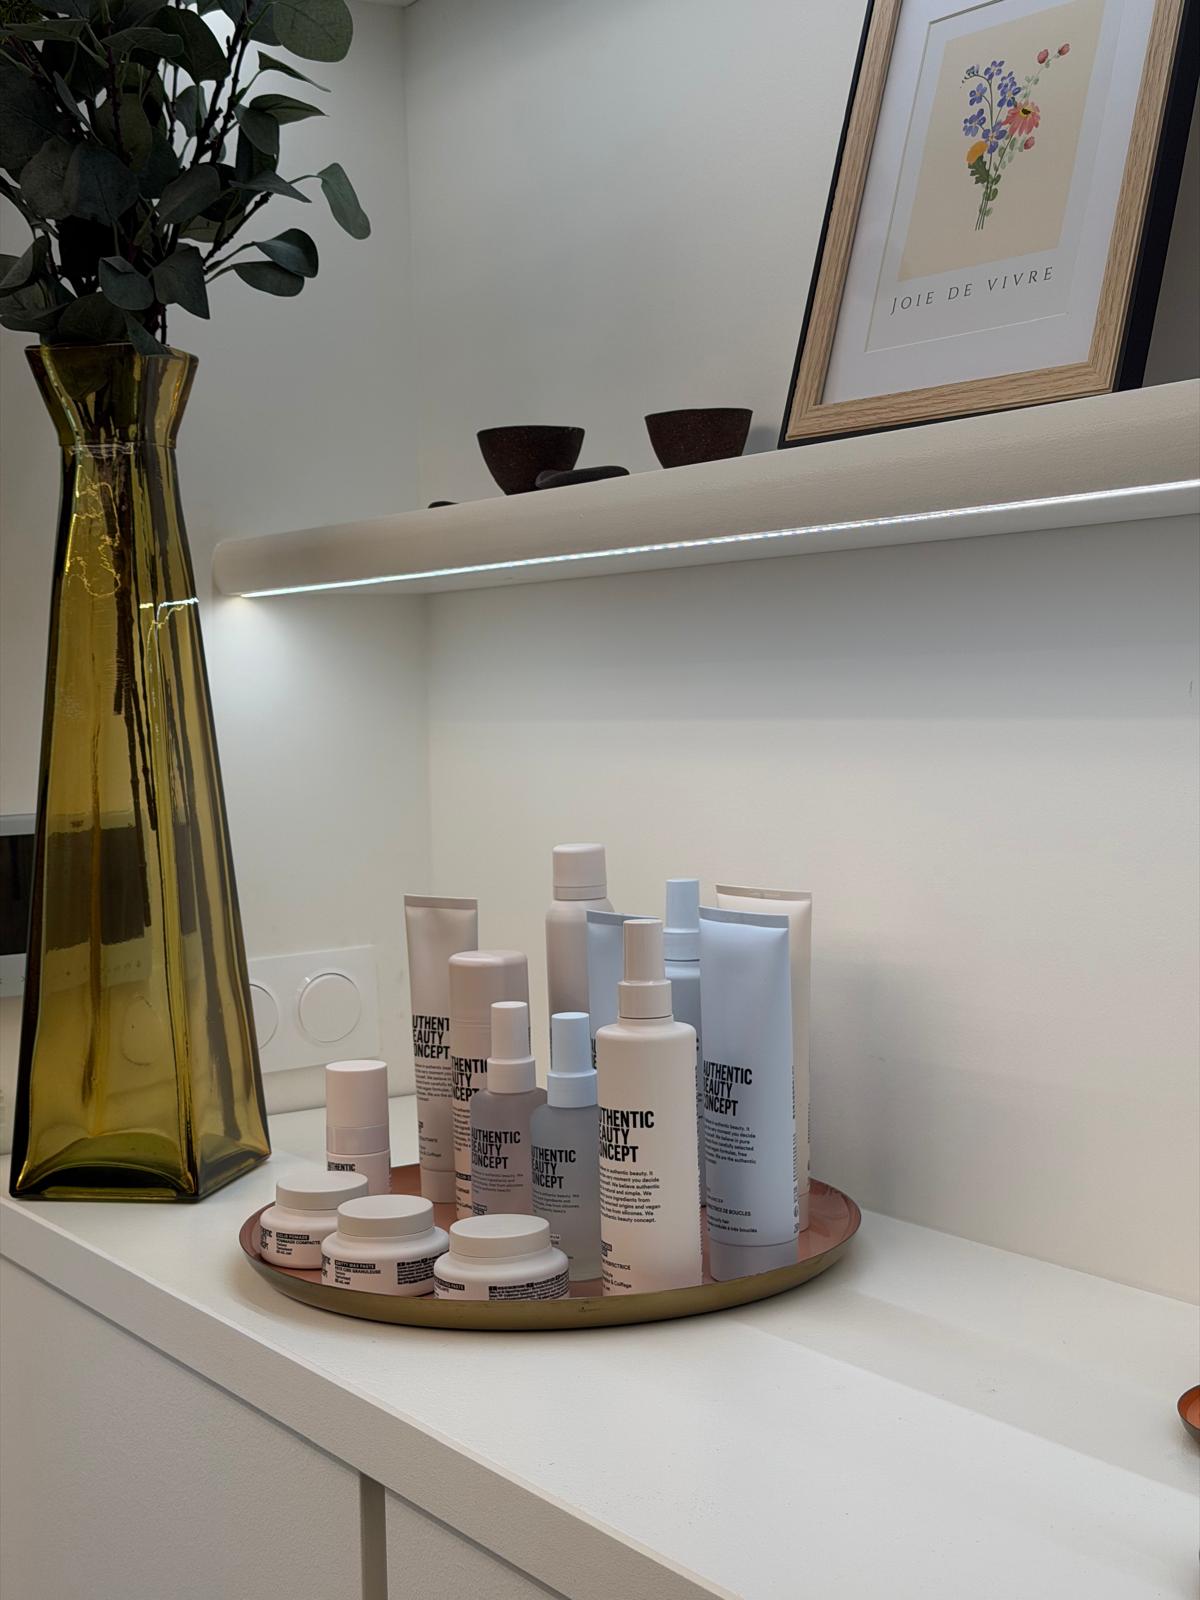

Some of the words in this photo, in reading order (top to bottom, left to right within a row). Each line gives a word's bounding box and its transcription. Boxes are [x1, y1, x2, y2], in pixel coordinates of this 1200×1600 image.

[890, 292, 934, 315] JOIE
[948, 284, 972, 300] DE
[988, 267, 1052, 292] VIVRE
[412, 1014, 450, 1031] UTHENT
[413, 1029, 444, 1045] EAUTY
[414, 1043, 450, 1059] ONCEPT
[599, 1107, 655, 1129] THENTIC
